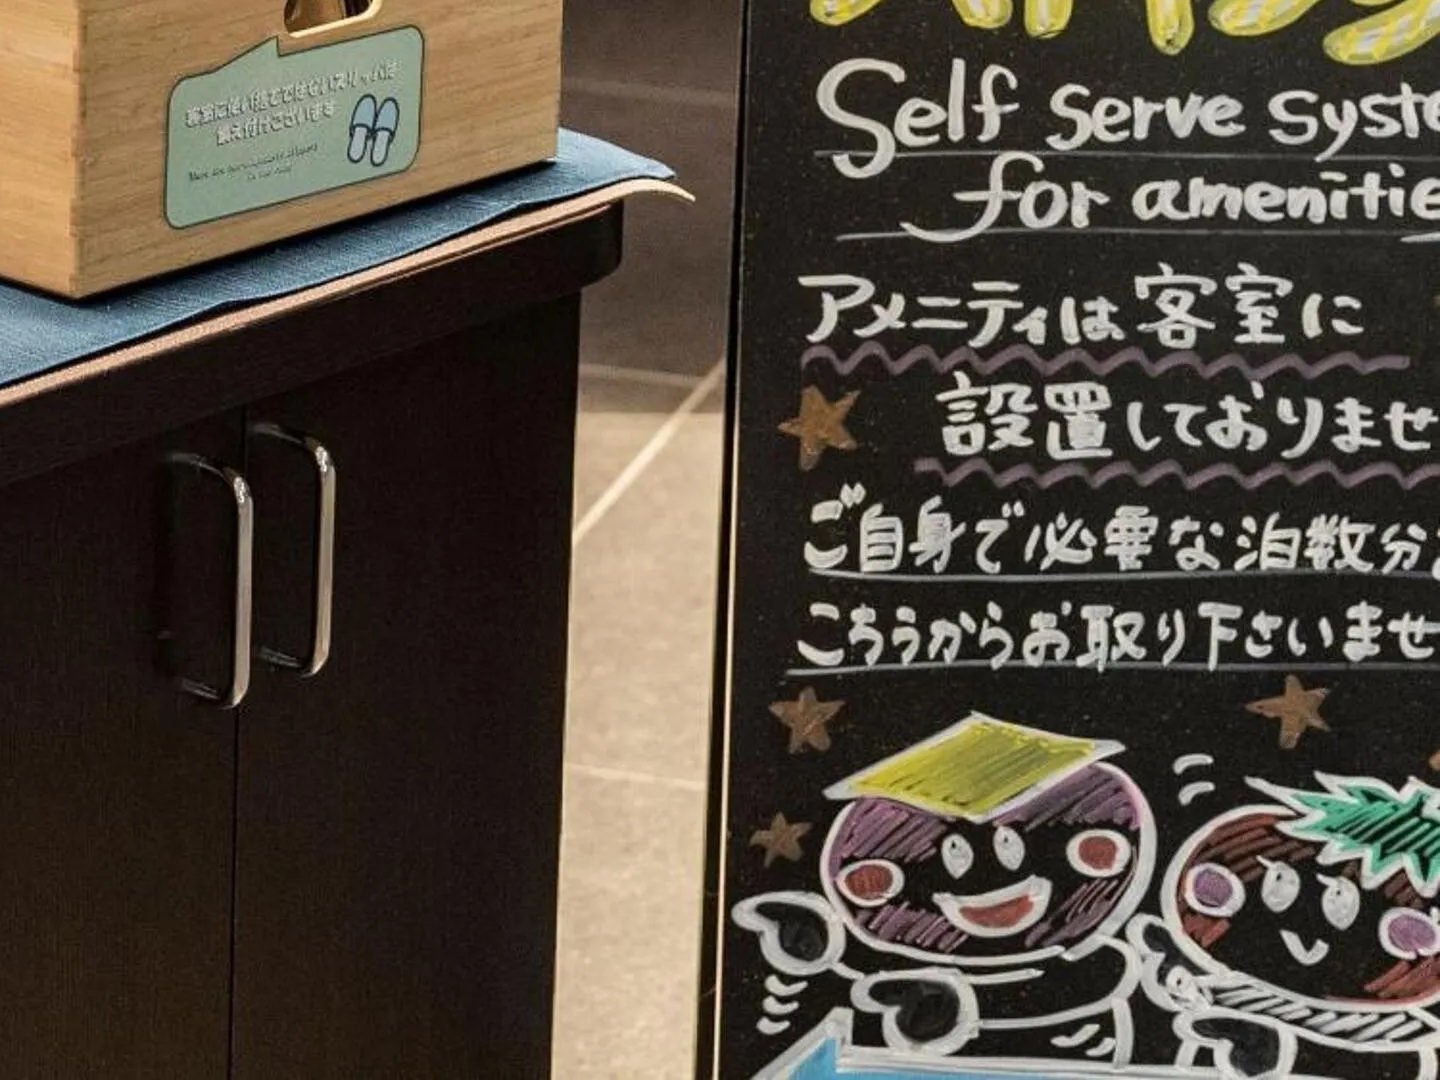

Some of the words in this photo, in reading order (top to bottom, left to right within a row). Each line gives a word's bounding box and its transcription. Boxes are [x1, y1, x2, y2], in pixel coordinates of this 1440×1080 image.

[816, 58, 1020, 179] Self
[901, 151, 1111, 243] for
[797, 262, 1366, 350] アメニティは客室に
[803, 482, 1440, 576] ご自身で必要な泊数分
